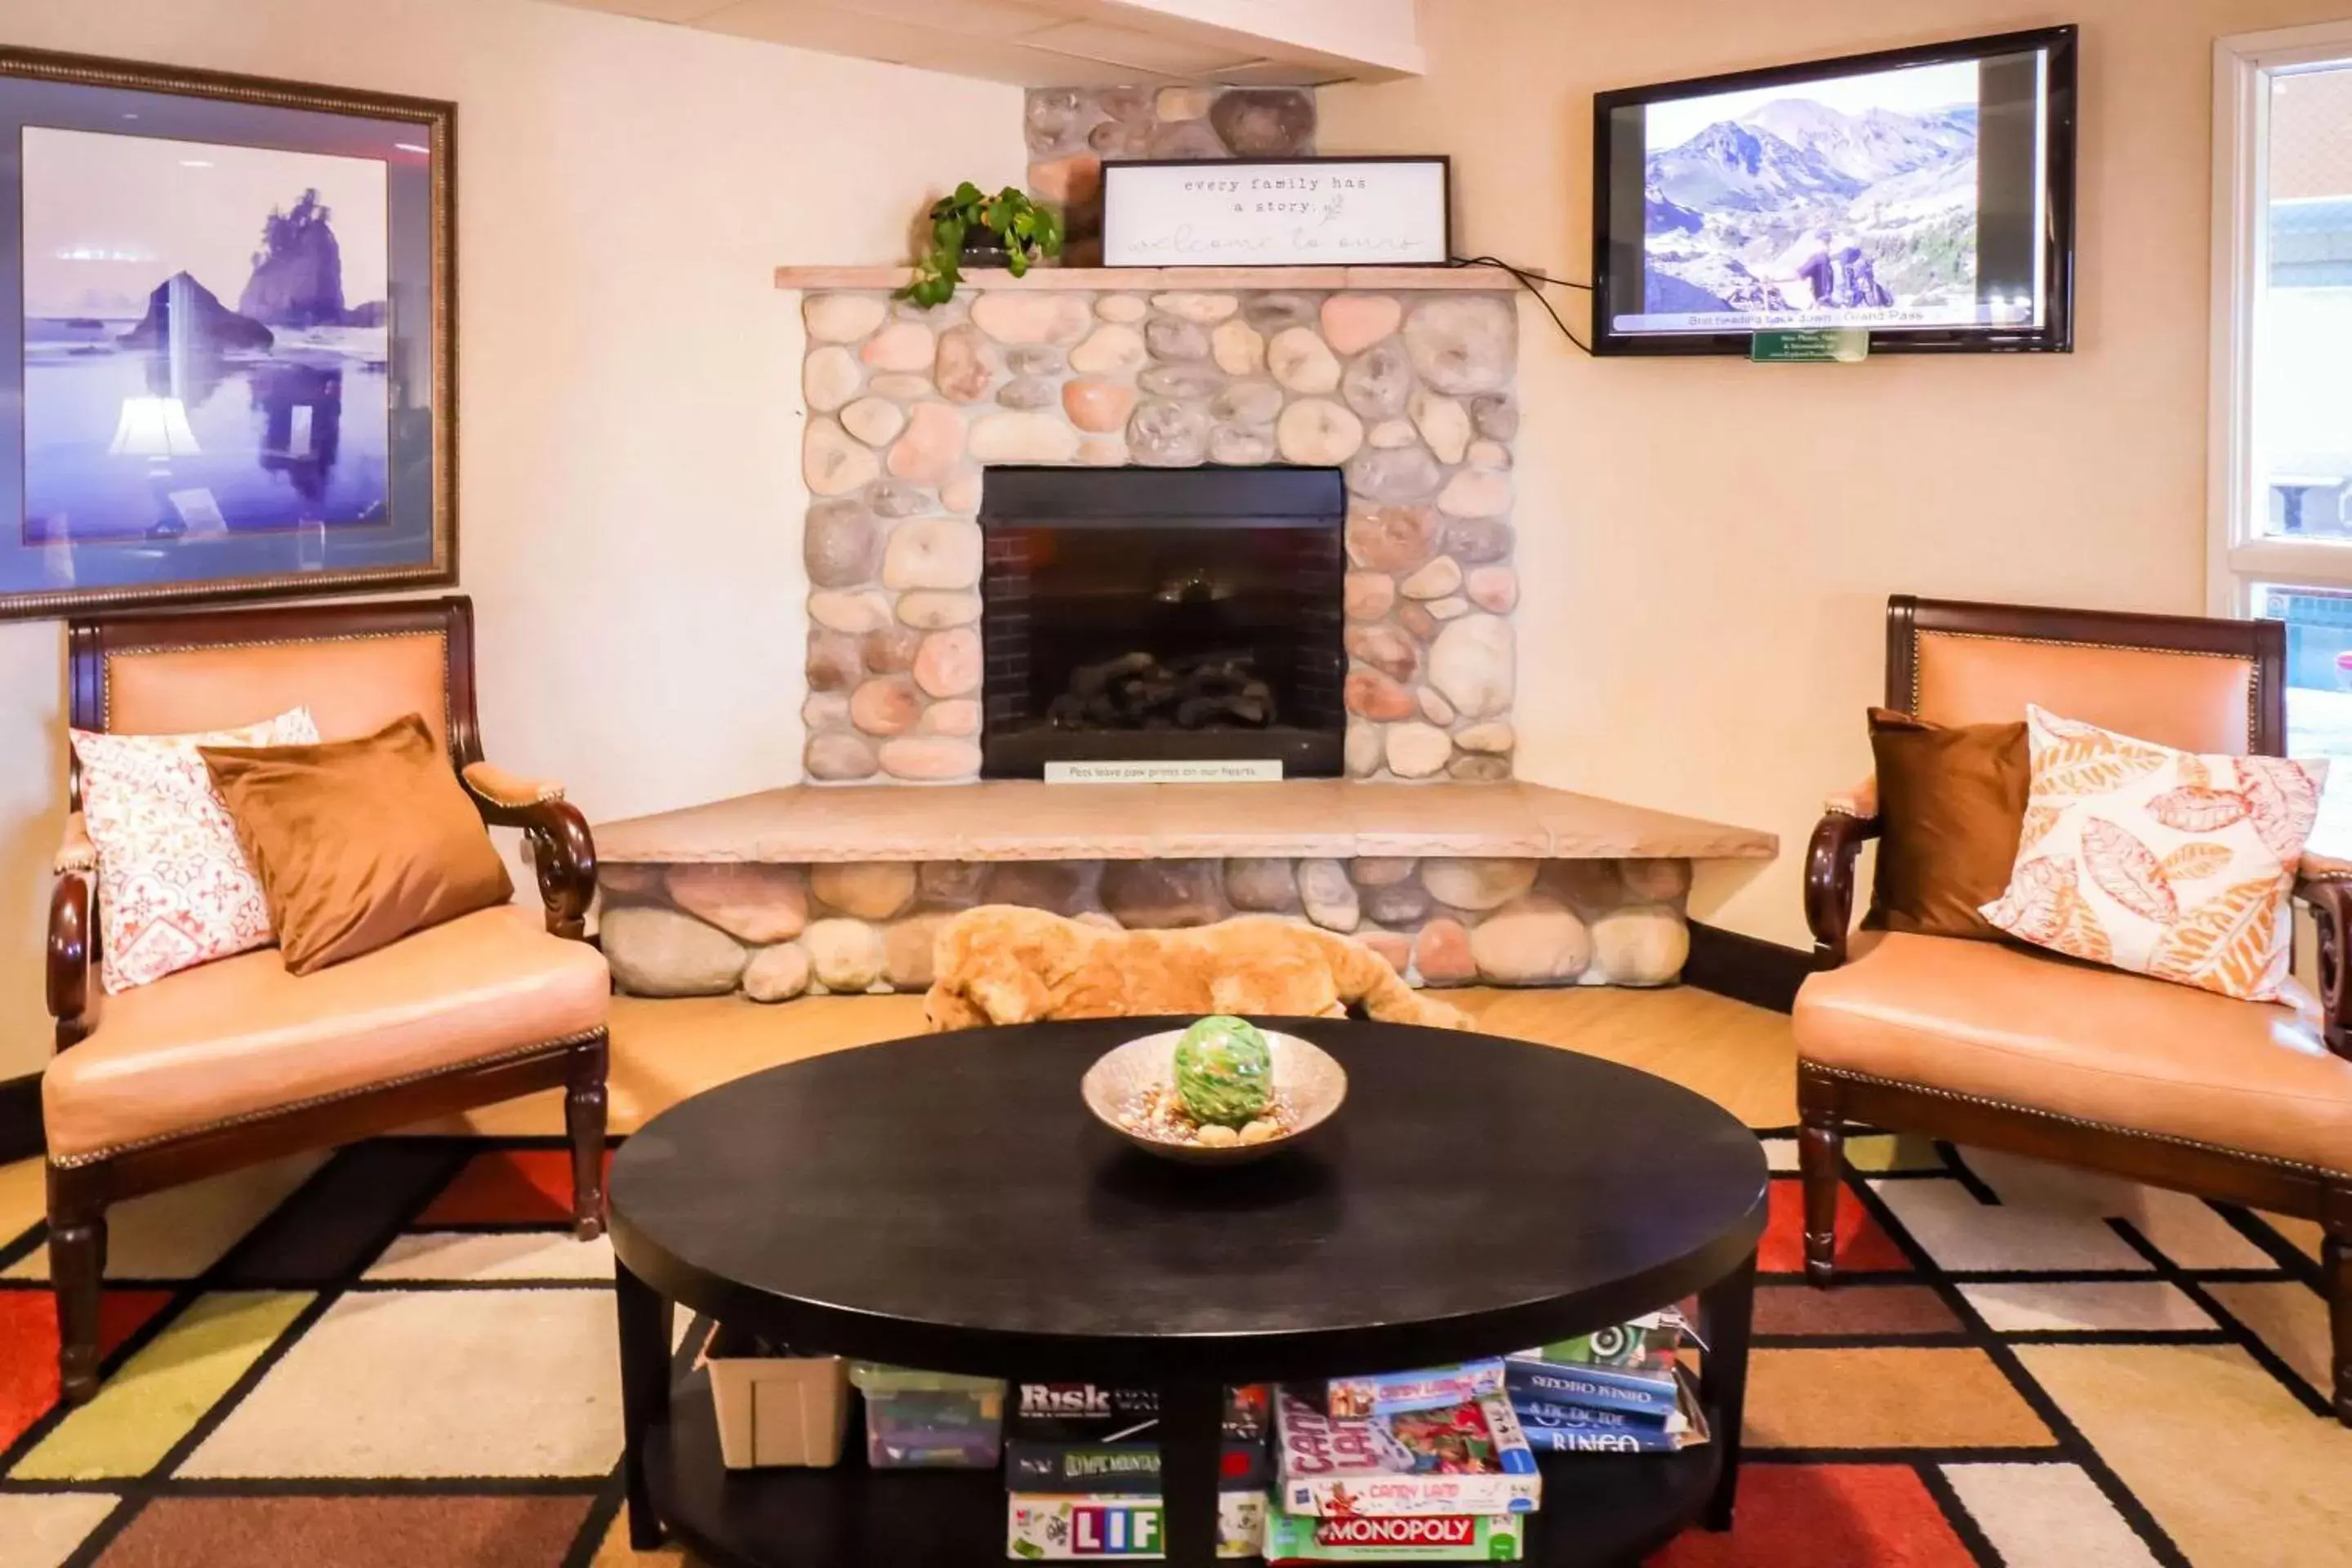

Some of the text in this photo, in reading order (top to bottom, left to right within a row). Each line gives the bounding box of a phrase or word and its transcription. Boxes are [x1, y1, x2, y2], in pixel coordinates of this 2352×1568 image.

[1183, 176, 1366, 193] every family has
[1233, 203, 1244, 213] a
[1887, 310, 1925, 321] Pass
[1076, 1510, 1160, 1549] LIF
[1329, 1518, 1471, 1541] MONOPOLY
